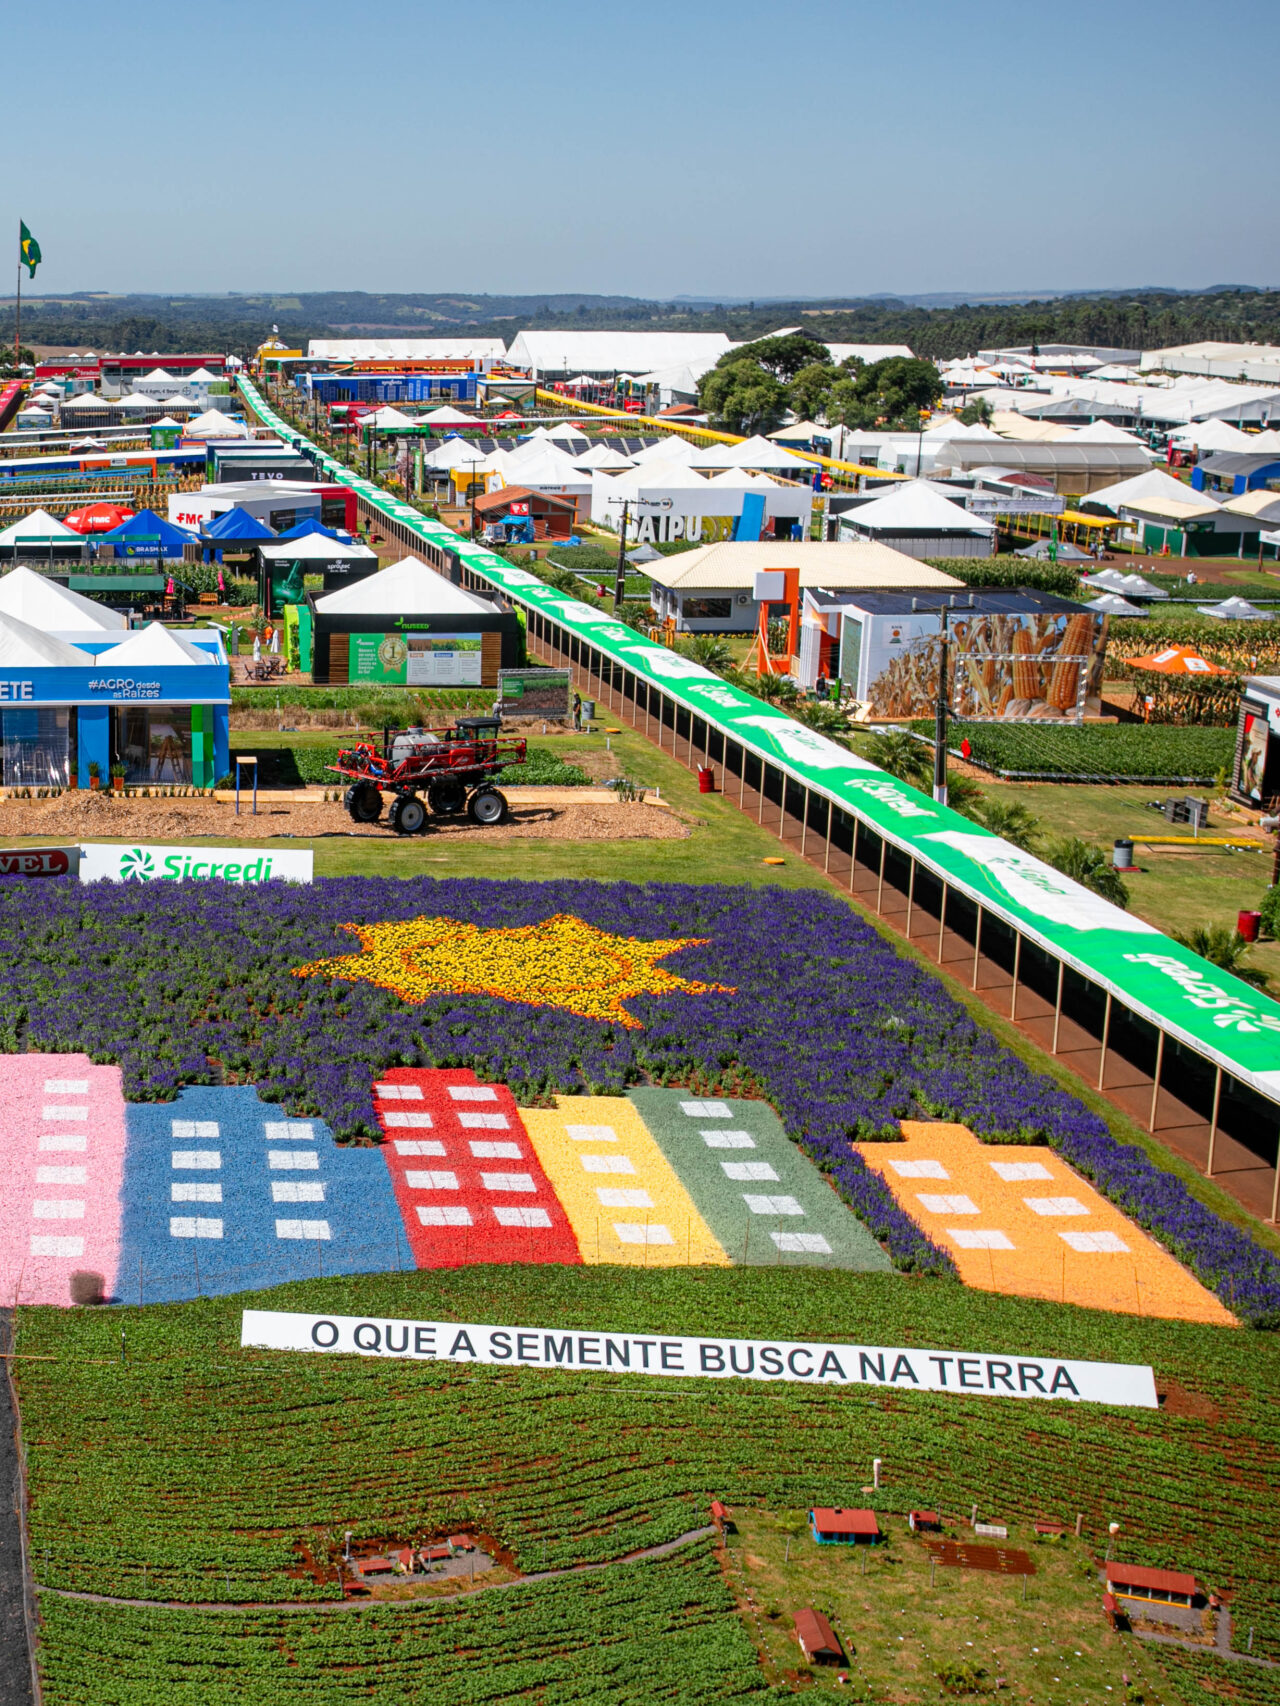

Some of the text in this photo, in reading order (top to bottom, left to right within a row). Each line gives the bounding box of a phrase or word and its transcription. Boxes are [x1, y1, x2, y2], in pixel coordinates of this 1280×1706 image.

[251, 472, 284, 480] TEVO
[88, 678, 161, 689] #AGRO desde
[161, 855, 273, 882] Sicredi
[311, 1320, 1080, 1395] O QUE A SEMENTE BUSCA NA TERRA
